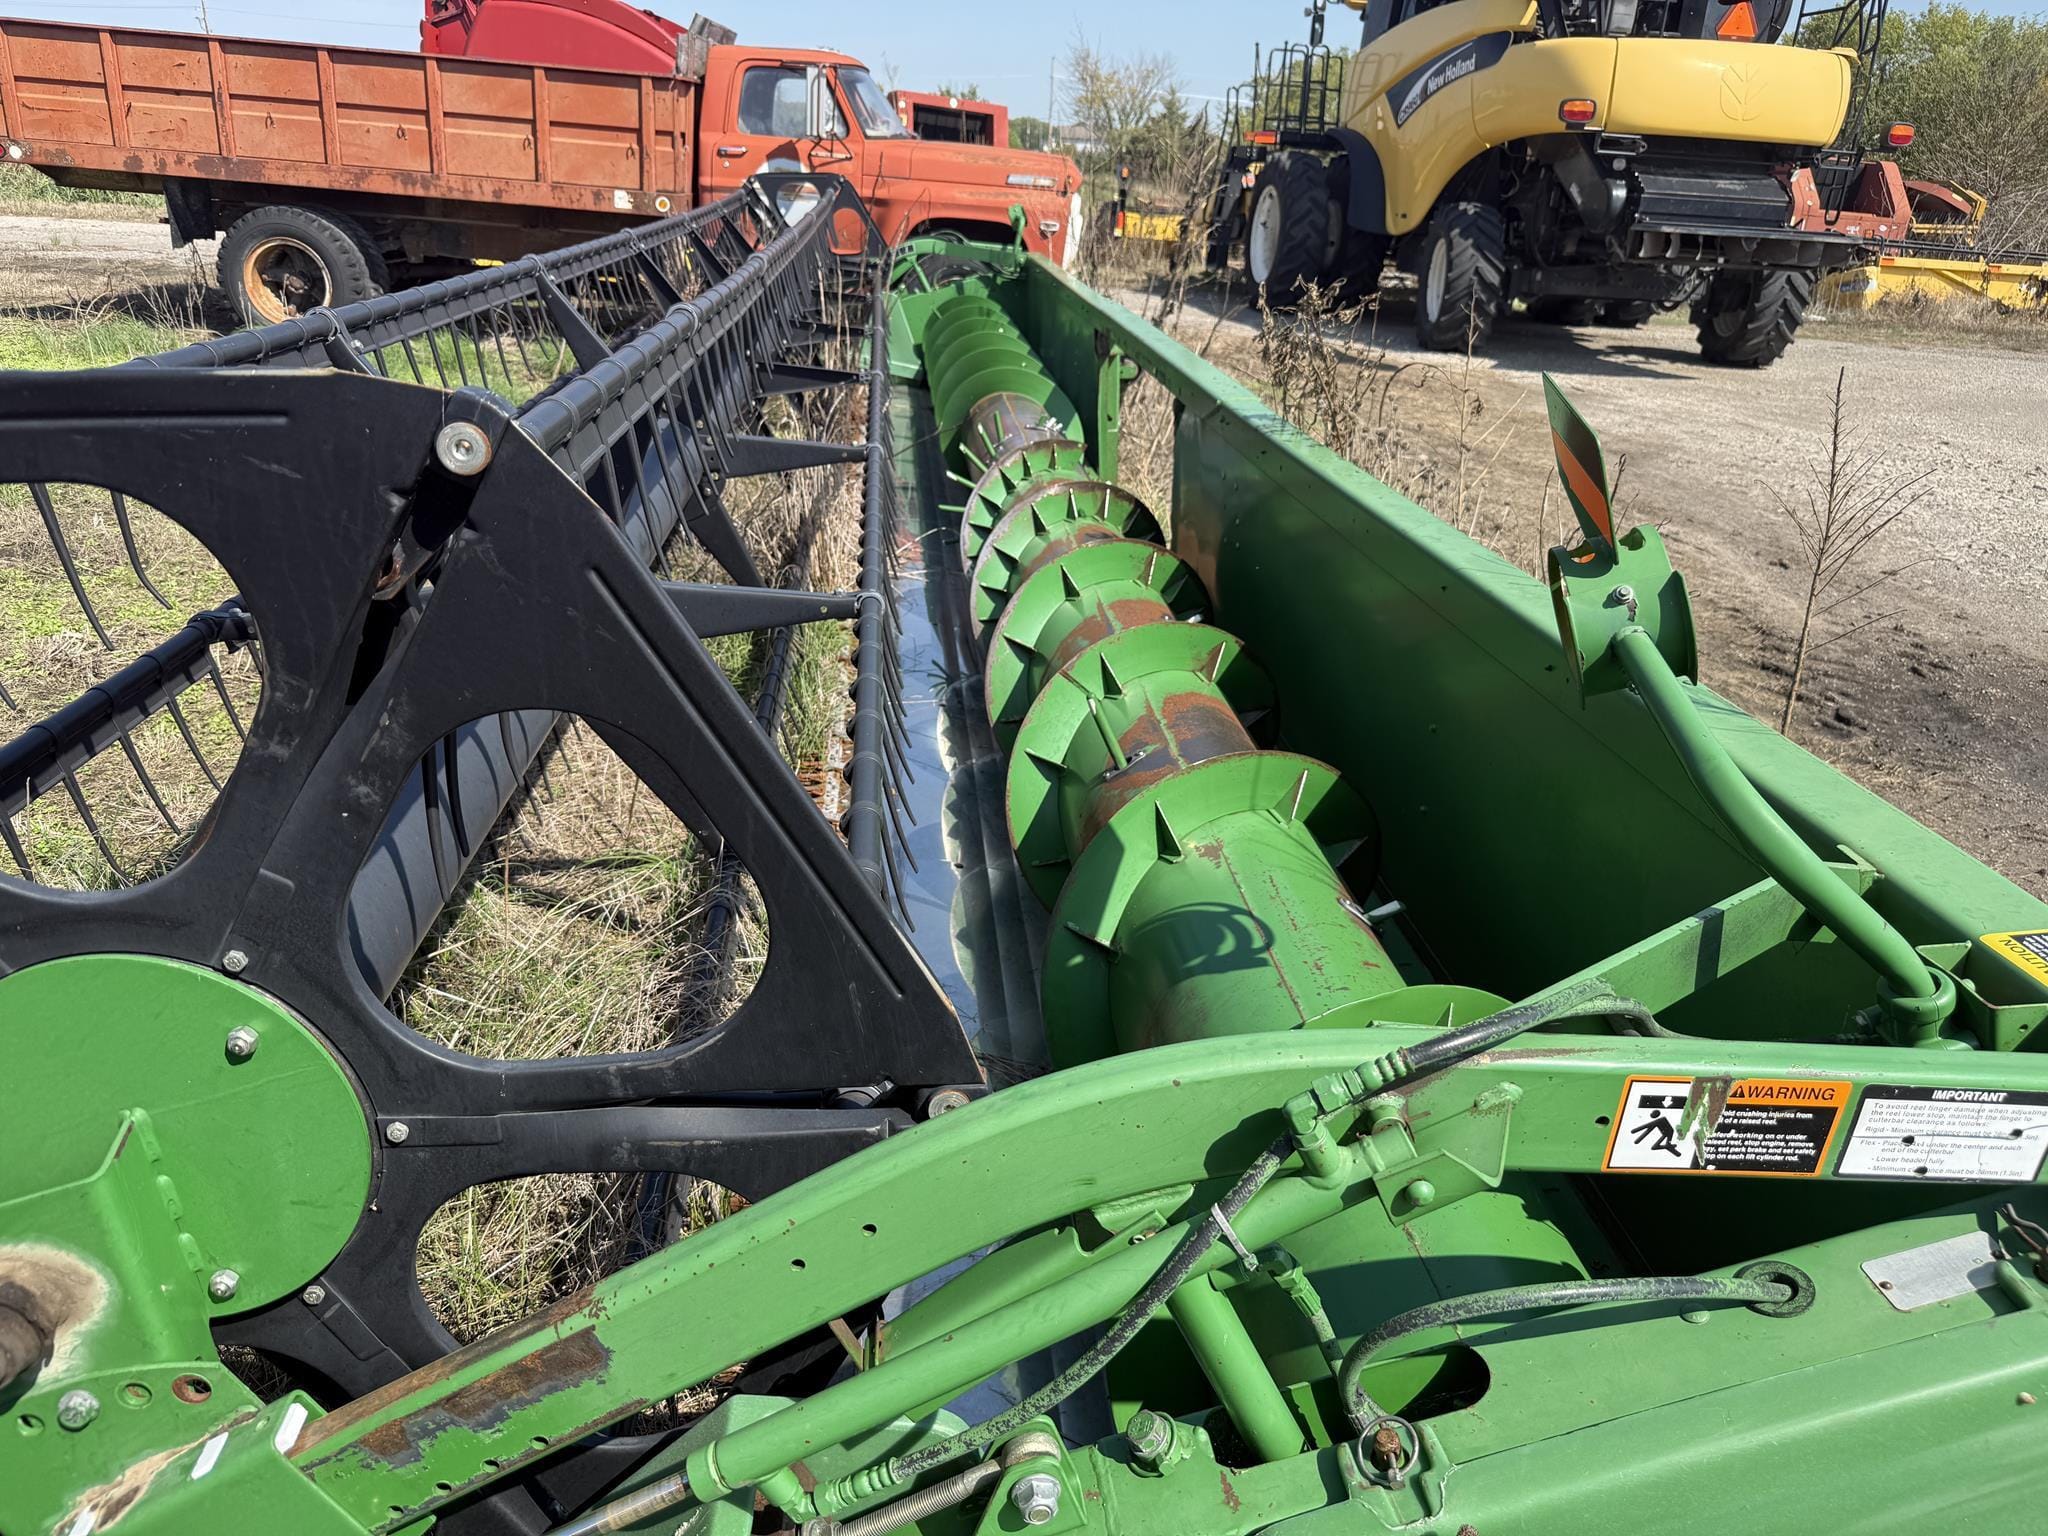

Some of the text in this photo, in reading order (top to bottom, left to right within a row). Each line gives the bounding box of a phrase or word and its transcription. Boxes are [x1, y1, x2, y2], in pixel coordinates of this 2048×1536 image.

[1427, 53, 1476, 95] New Holland
[1998, 939, 2048, 974] UTION
[1748, 1086, 1836, 1101] WARNING
[1932, 1090, 2007, 1102] IMPORTANT
[1736, 1110, 1767, 1119] crushing
[1768, 1111, 1795, 1119] injuries
[1795, 1111, 1813, 1119] from
[1928, 1104, 1952, 1113] finger
[1953, 1105, 1986, 1114] damage
[2010, 1108, 2048, 1117] adjusting
[1948, 1112, 1983, 1120] maintain
[1739, 1117, 1761, 1125] raised
[1865, 1126, 1885, 1134] Rigid
[1744, 1139, 1760, 1147] stop
[1761, 1140, 1786, 1148] engine,
[1795, 1148, 1816, 1156] safety
[1920, 1147, 1954, 1155] cutterbar
[1756, 1154, 1785, 1162] cylinder
[1928, 1157, 1945, 1165] fully
